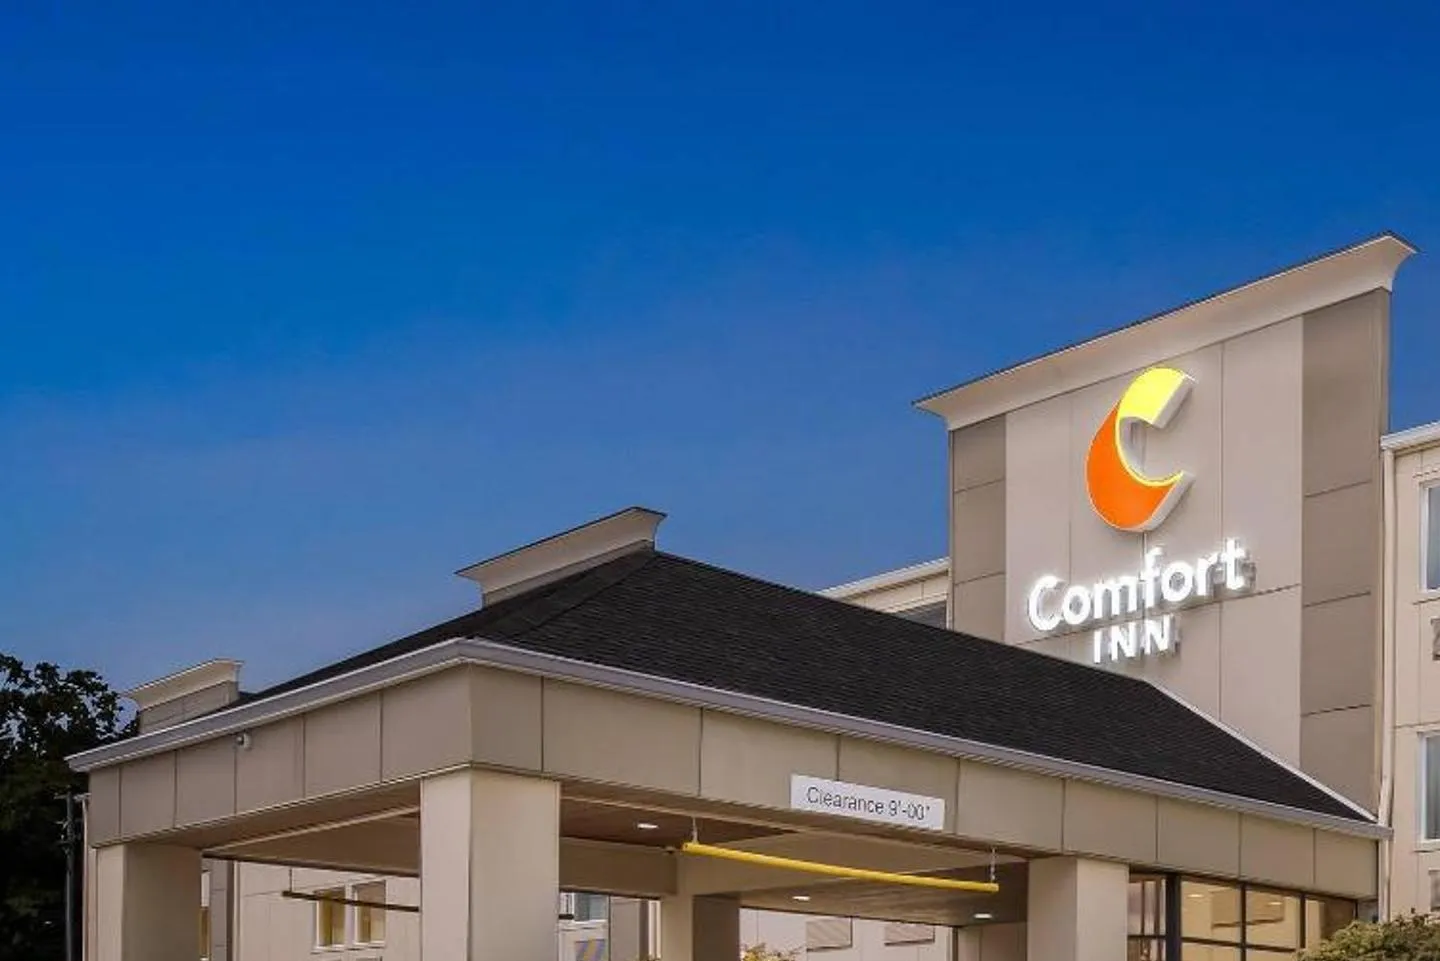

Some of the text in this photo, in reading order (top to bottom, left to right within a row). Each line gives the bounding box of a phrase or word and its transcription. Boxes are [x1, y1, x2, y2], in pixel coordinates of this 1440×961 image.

[1027, 538, 1250, 632] Comfort
[1091, 613, 1176, 664] INN
[806, 786, 885, 814] Clearance
